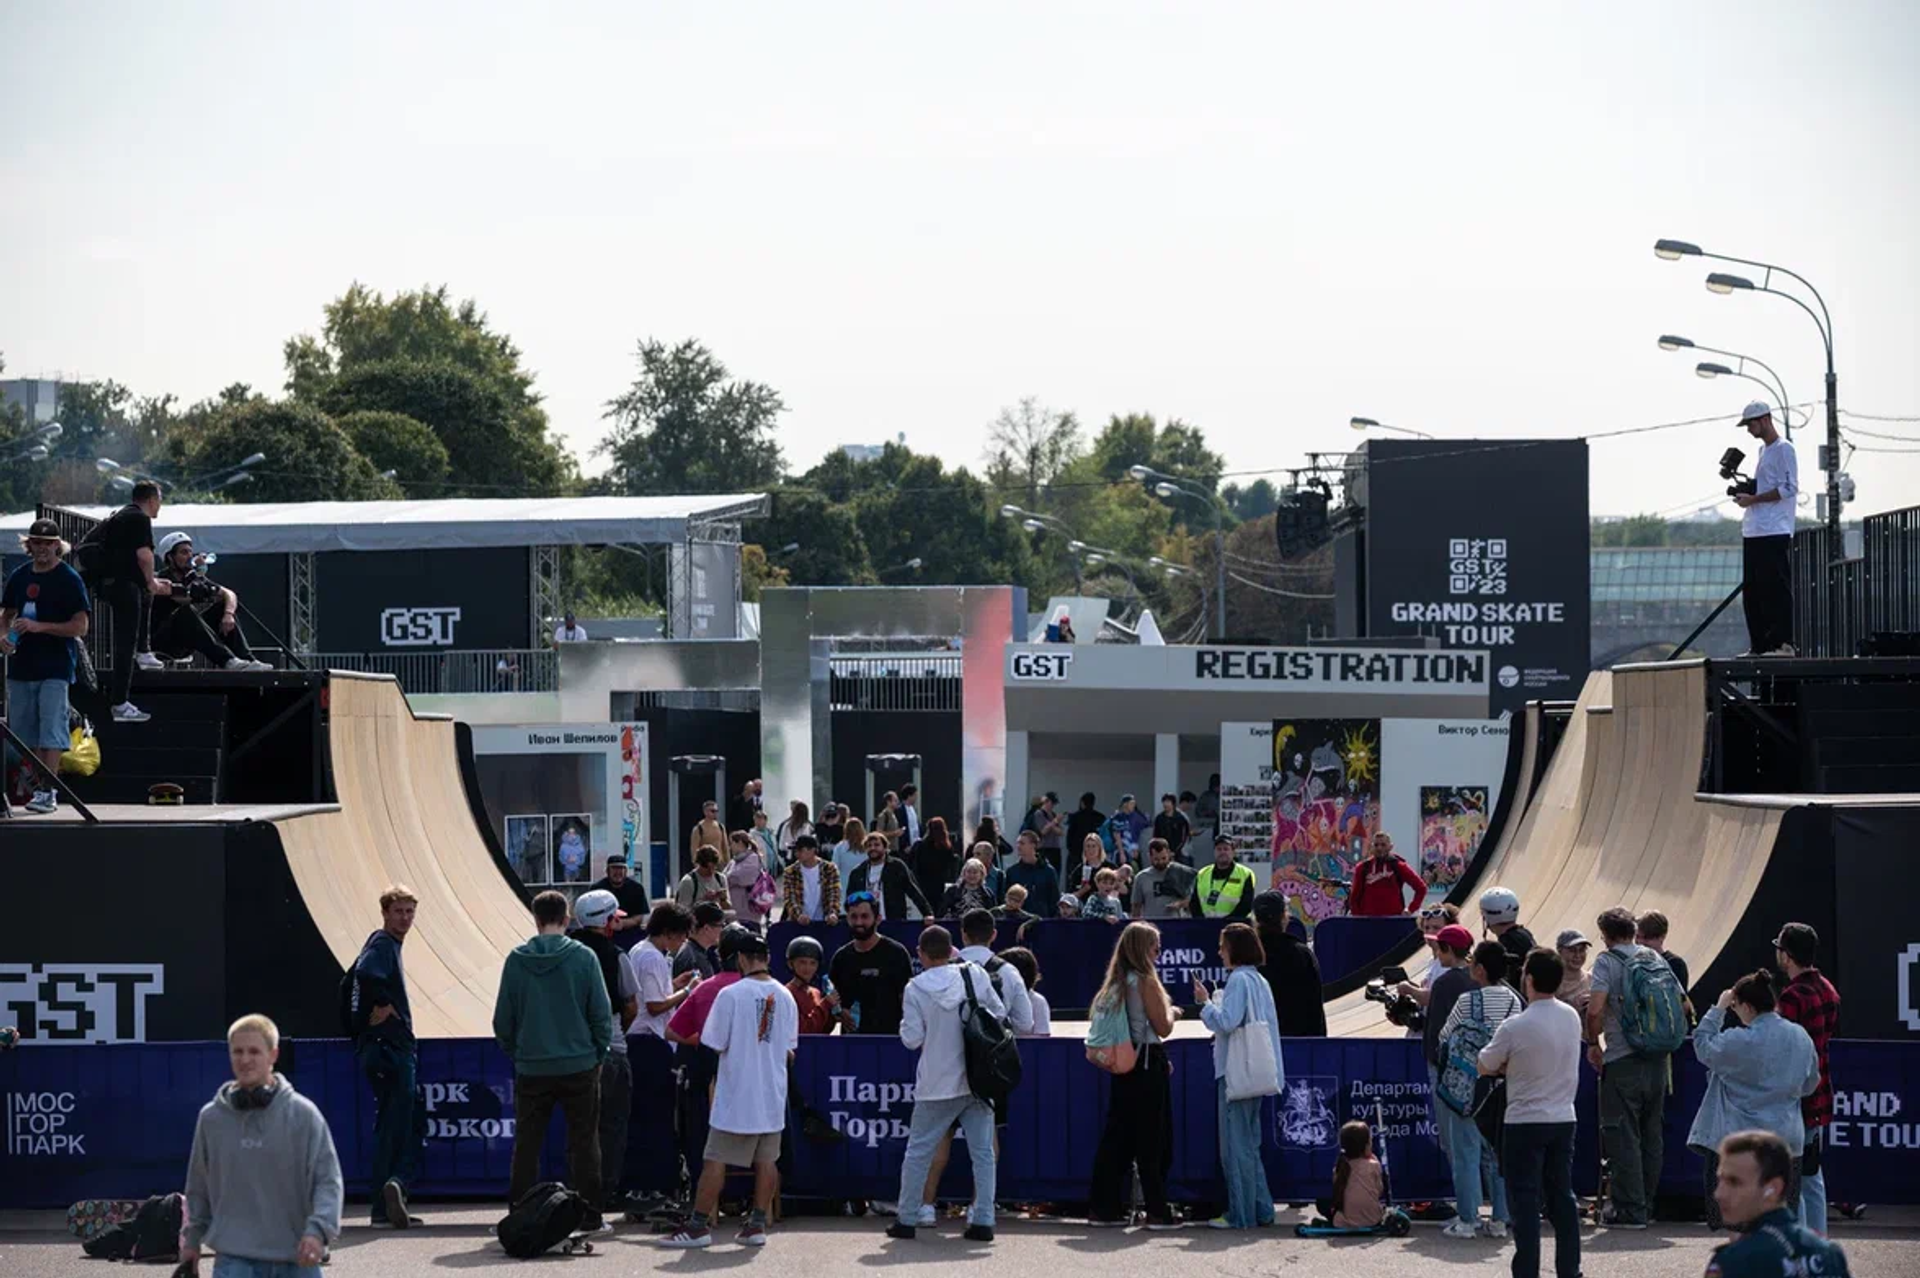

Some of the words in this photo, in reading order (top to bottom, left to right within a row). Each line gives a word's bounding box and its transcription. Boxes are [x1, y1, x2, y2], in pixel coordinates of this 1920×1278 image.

[1450, 559, 1494, 574] GST
[1391, 602, 1478, 622] GRAND
[1481, 602, 1565, 622] SKATE
[383, 609, 459, 643] GST
[1445, 625, 1515, 645] TOUR
[1013, 653, 1071, 678] GST
[1196, 651, 1484, 683] REGISTRATION
[528, 733, 560, 745] Иван
[563, 733, 618, 744] Шепилов
[1438, 725, 1478, 737] Виктор
[15, 1092, 75, 1113] МОС
[16, 1113, 66, 1134] ГОР
[16, 1134, 86, 1155] ПАРК
